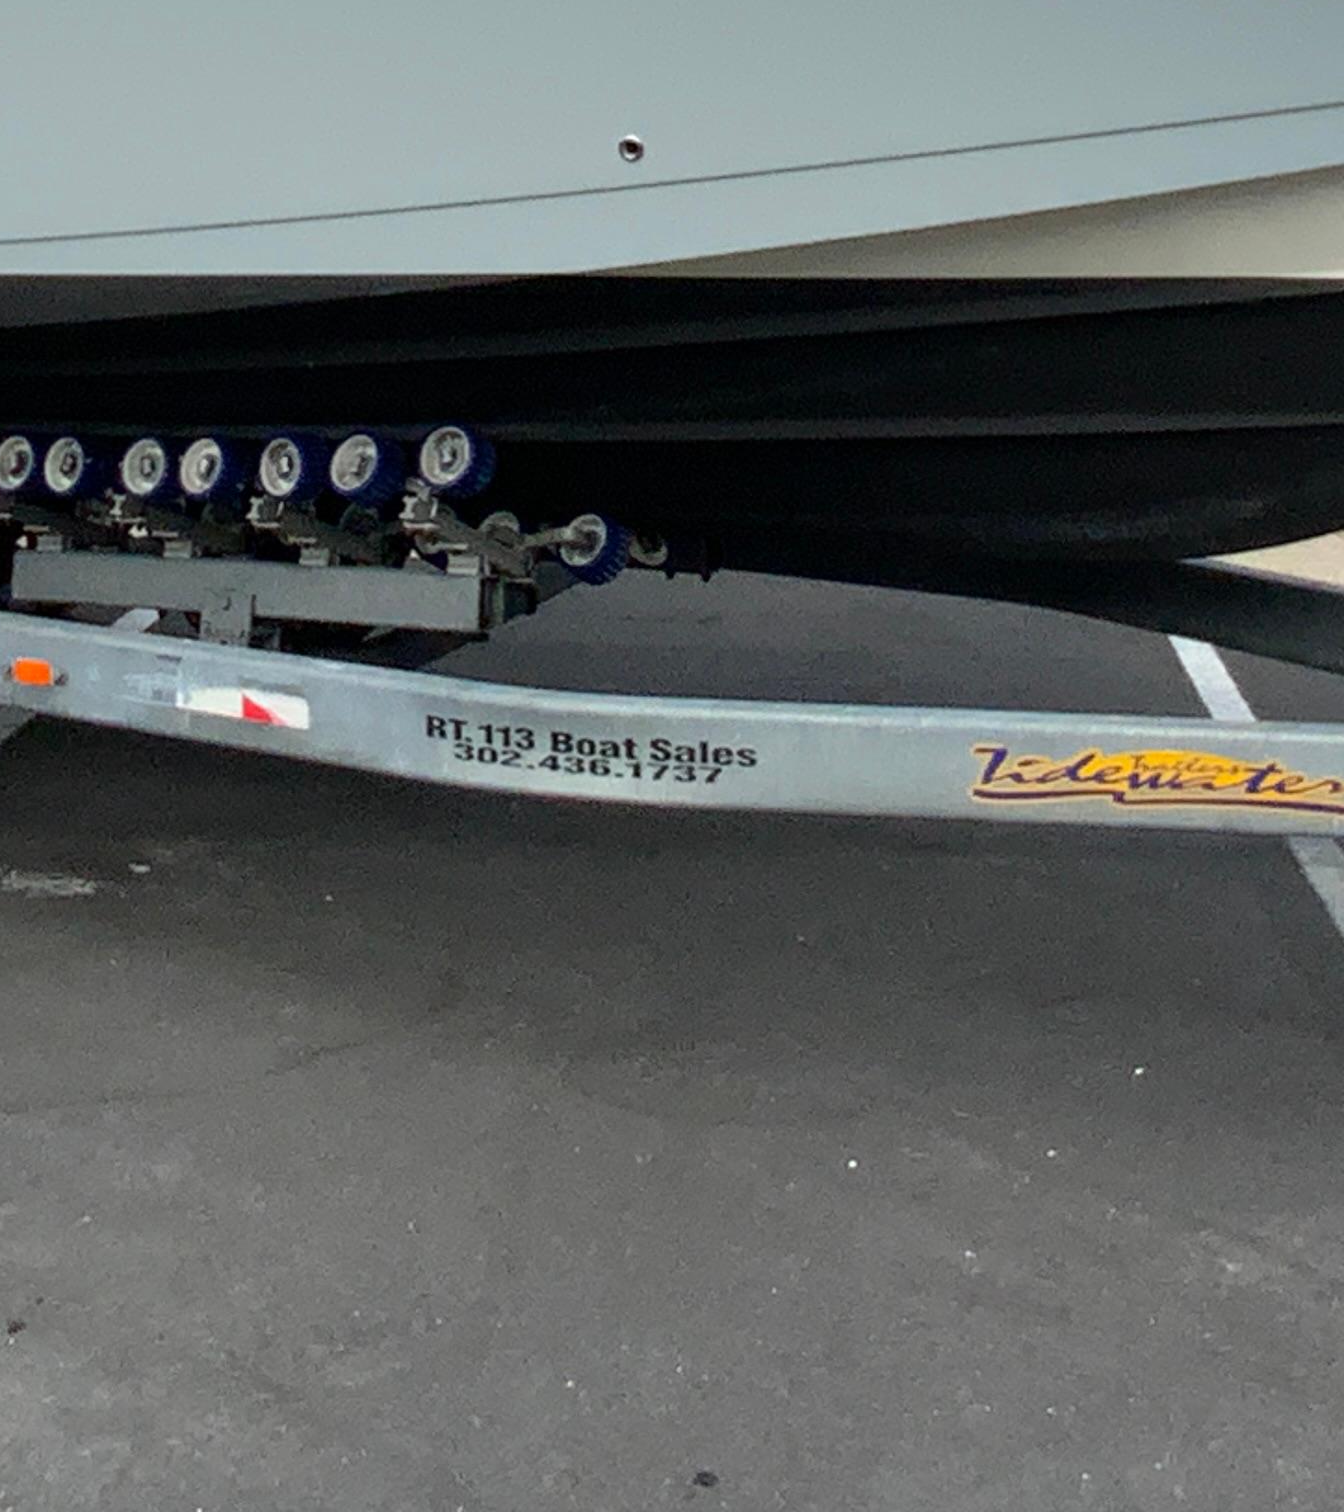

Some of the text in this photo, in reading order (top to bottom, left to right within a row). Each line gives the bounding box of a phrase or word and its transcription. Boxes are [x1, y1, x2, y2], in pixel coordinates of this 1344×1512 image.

[454, 742, 723, 784] 302.436.1737
[550, 731, 637, 761] Boat
[650, 738, 758, 768] Sales
